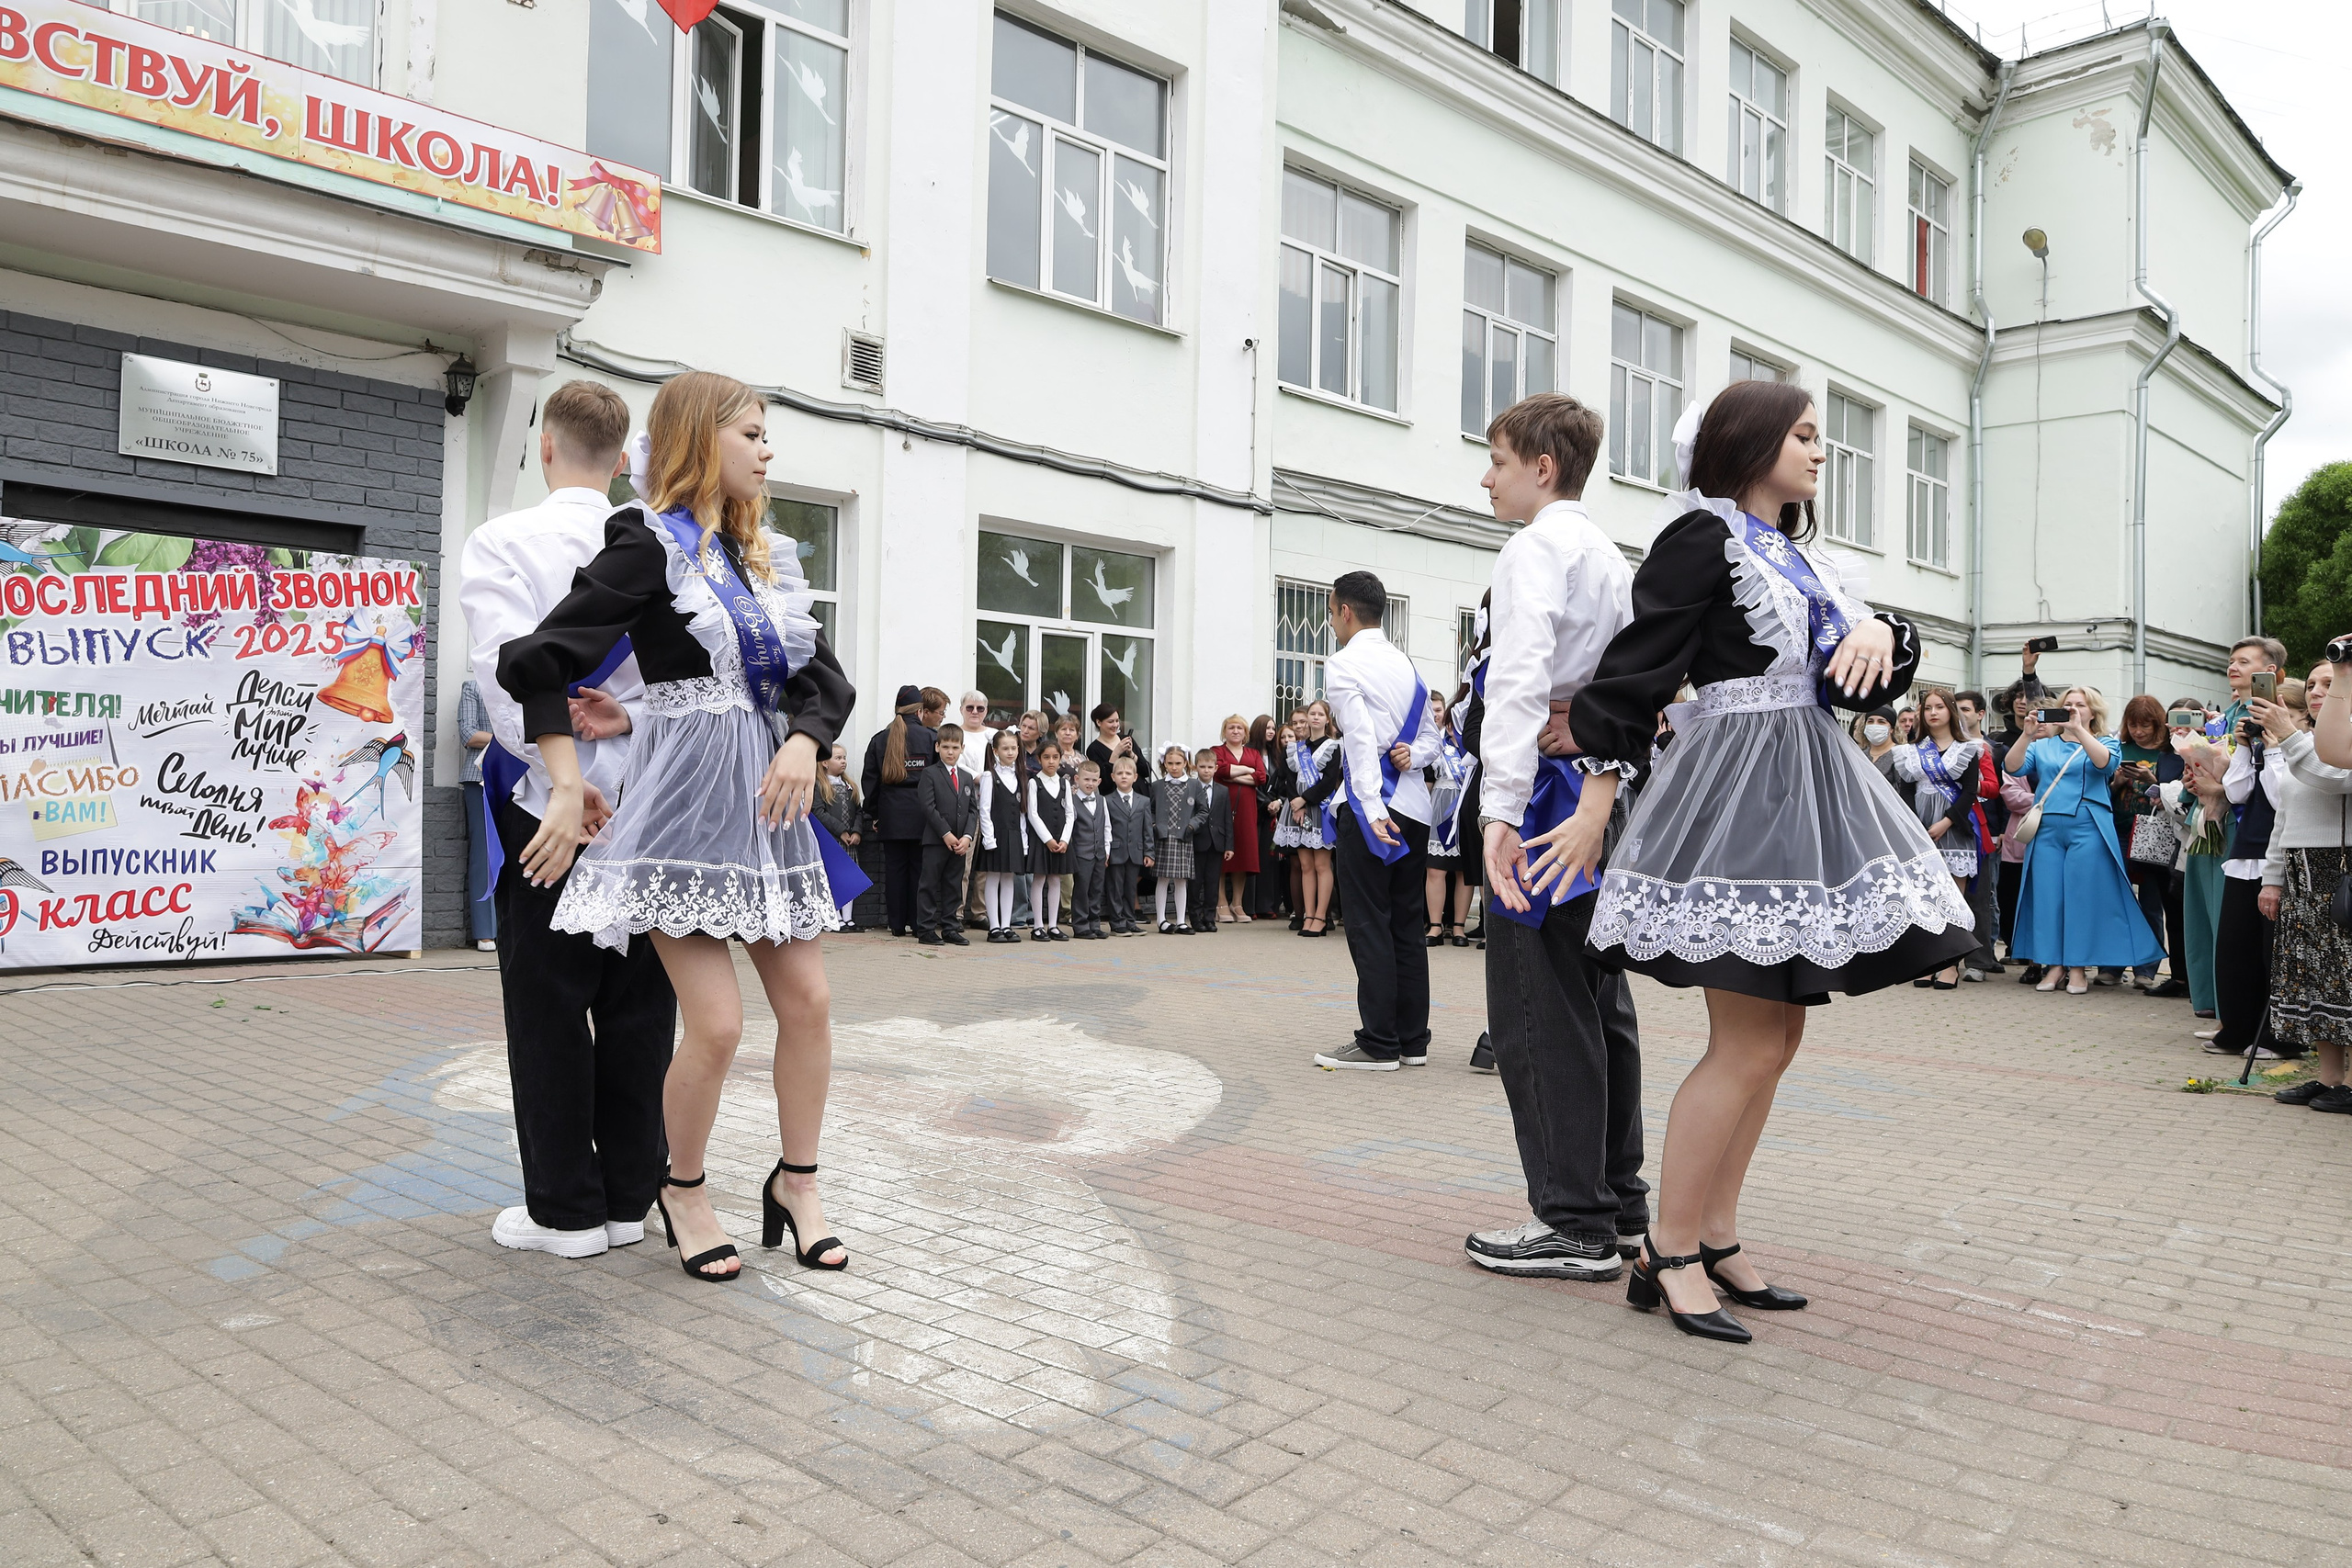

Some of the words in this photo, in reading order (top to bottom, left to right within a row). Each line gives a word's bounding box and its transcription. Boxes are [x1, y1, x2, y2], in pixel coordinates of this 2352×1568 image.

[304, 95, 561, 207] ШКОЛА!
[138, 406, 212, 423] МУНИЦИПАЛЬНОЕ
[212, 417, 264, 431] БЮДЖЕТНОЕ
[152, 415, 250, 436] ОБЩЕОБРАЗОВАТЕЛЬНОЕ
[175, 426, 229, 440] УЧРЕЖДЕНИЕ
[135, 435, 212, 457] «ШКОЛА
[217, 446, 237, 460] №
[241, 450, 264, 464] 75»
[0, 568, 258, 621] ОСЛЕДНИЙ
[273, 571, 420, 610] ЗВОНОК
[7, 624, 217, 666] ВЫПУСК
[233, 620, 347, 660] 2025
[128, 694, 220, 731] Мечтай
[22, 728, 104, 752] ЛУЧШИЕ!
[157, 751, 265, 813] Сегодня
[45, 800, 107, 824] ВАМ!
[41, 848, 217, 875] ВЫПУСКНИК
[39, 883, 192, 931] класс
[88, 916, 227, 961] Действуй!
